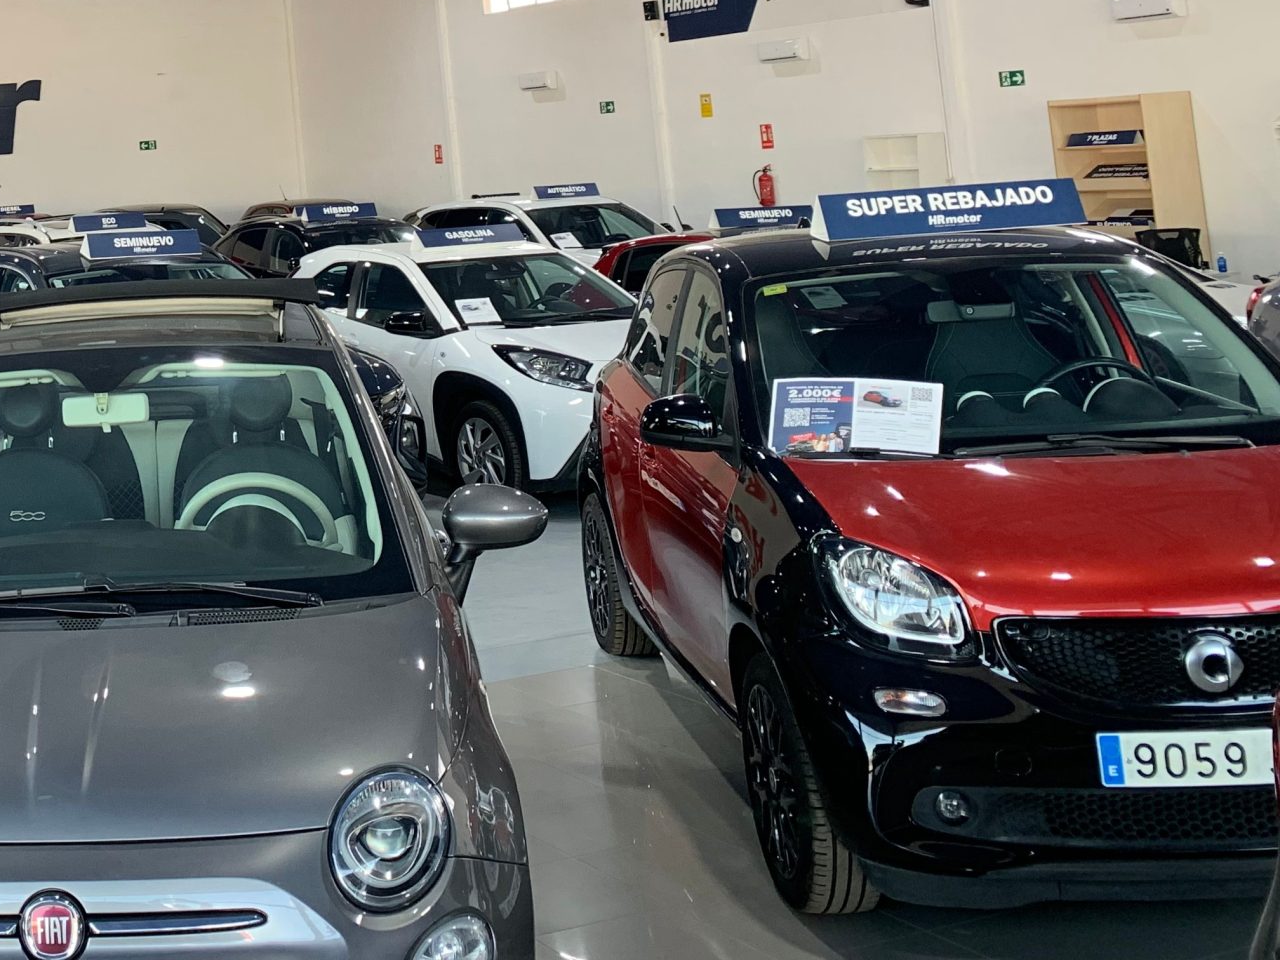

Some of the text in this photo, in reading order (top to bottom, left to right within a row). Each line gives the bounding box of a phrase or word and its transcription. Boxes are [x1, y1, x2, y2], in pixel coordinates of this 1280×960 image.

[1091, 133, 1118, 141] PLAZAS
[547, 185, 586, 194] AUTOMÁTICO
[846, 185, 1054, 217] SUPER REBAJADO
[323, 204, 359, 215] HÍBRIDO
[738, 207, 793, 220] SEMINUEVO
[101, 216, 116, 225] ECO
[928, 213, 982, 226] HRmotor
[444, 227, 495, 240] GASOLINA
[113, 235, 174, 248] SEMINUEVO
[1108, 742, 1248, 778] E 9059
[36, 916, 69, 945] FIAT
